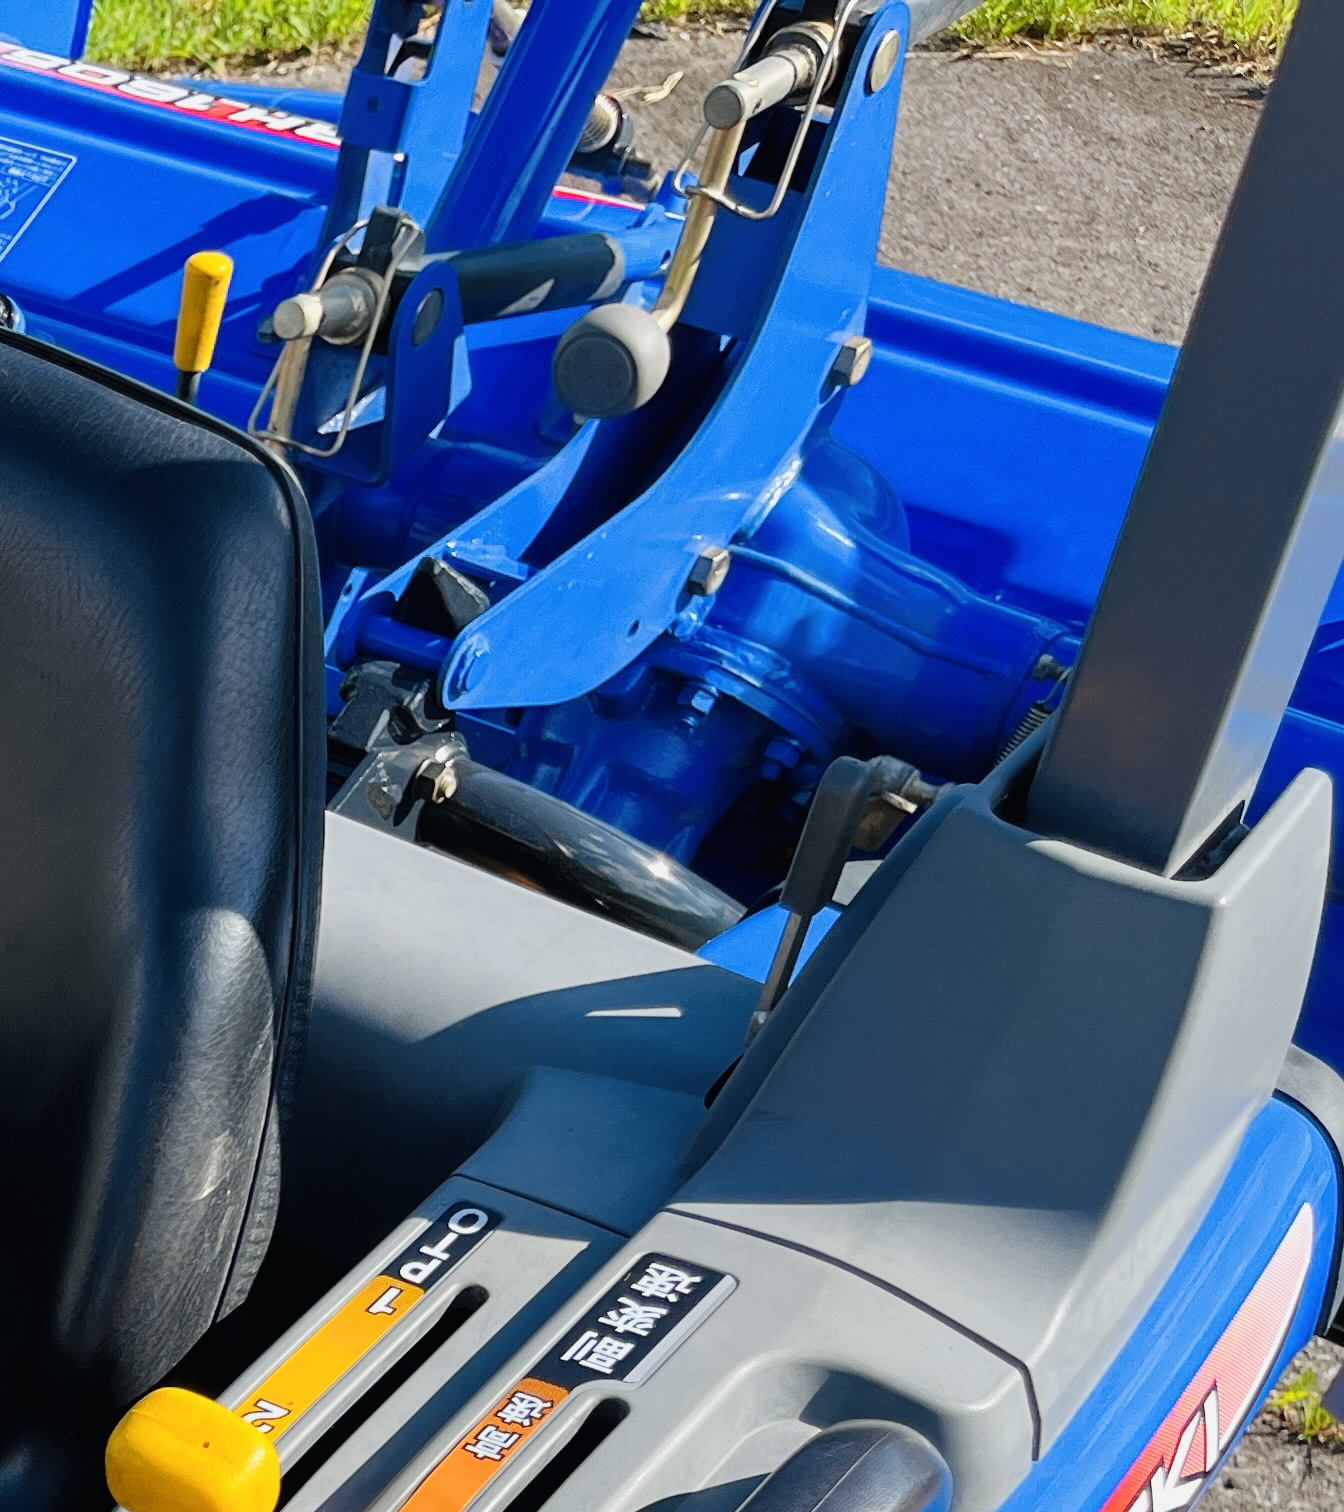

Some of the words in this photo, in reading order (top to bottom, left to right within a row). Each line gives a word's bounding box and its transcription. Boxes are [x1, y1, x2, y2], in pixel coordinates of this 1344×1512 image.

[399, 1208, 491, 1285] PTO
[365, 1286, 403, 1317] 1
[561, 1262, 705, 1377] 副変速
[464, 1391, 555, 1462] 高速
